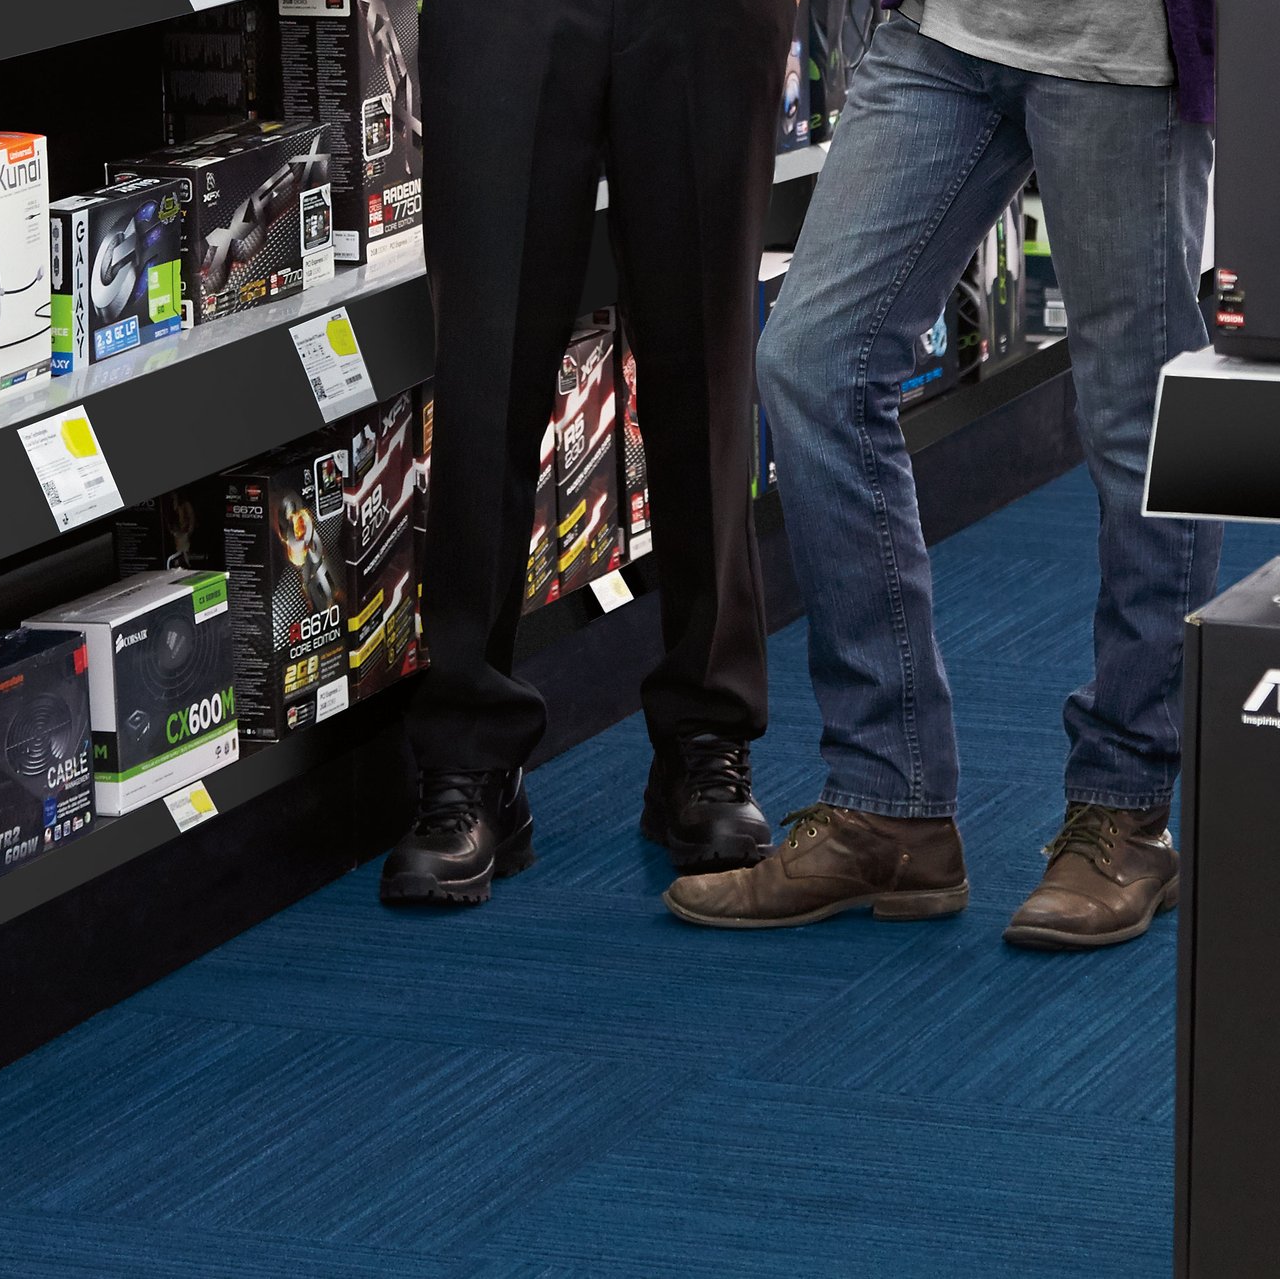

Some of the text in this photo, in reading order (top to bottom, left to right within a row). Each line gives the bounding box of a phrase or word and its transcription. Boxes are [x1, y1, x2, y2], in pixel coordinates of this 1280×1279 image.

[203, 190, 220, 203] XFX
[383, 178, 422, 205] RADEON
[123, 628, 148, 648] CORSAIR
[290, 628, 341, 660] CORE EDITION
[166, 686, 235, 745] CX600M
[47, 752, 88, 789] CABLE
[5, 836, 39, 864] 600W
